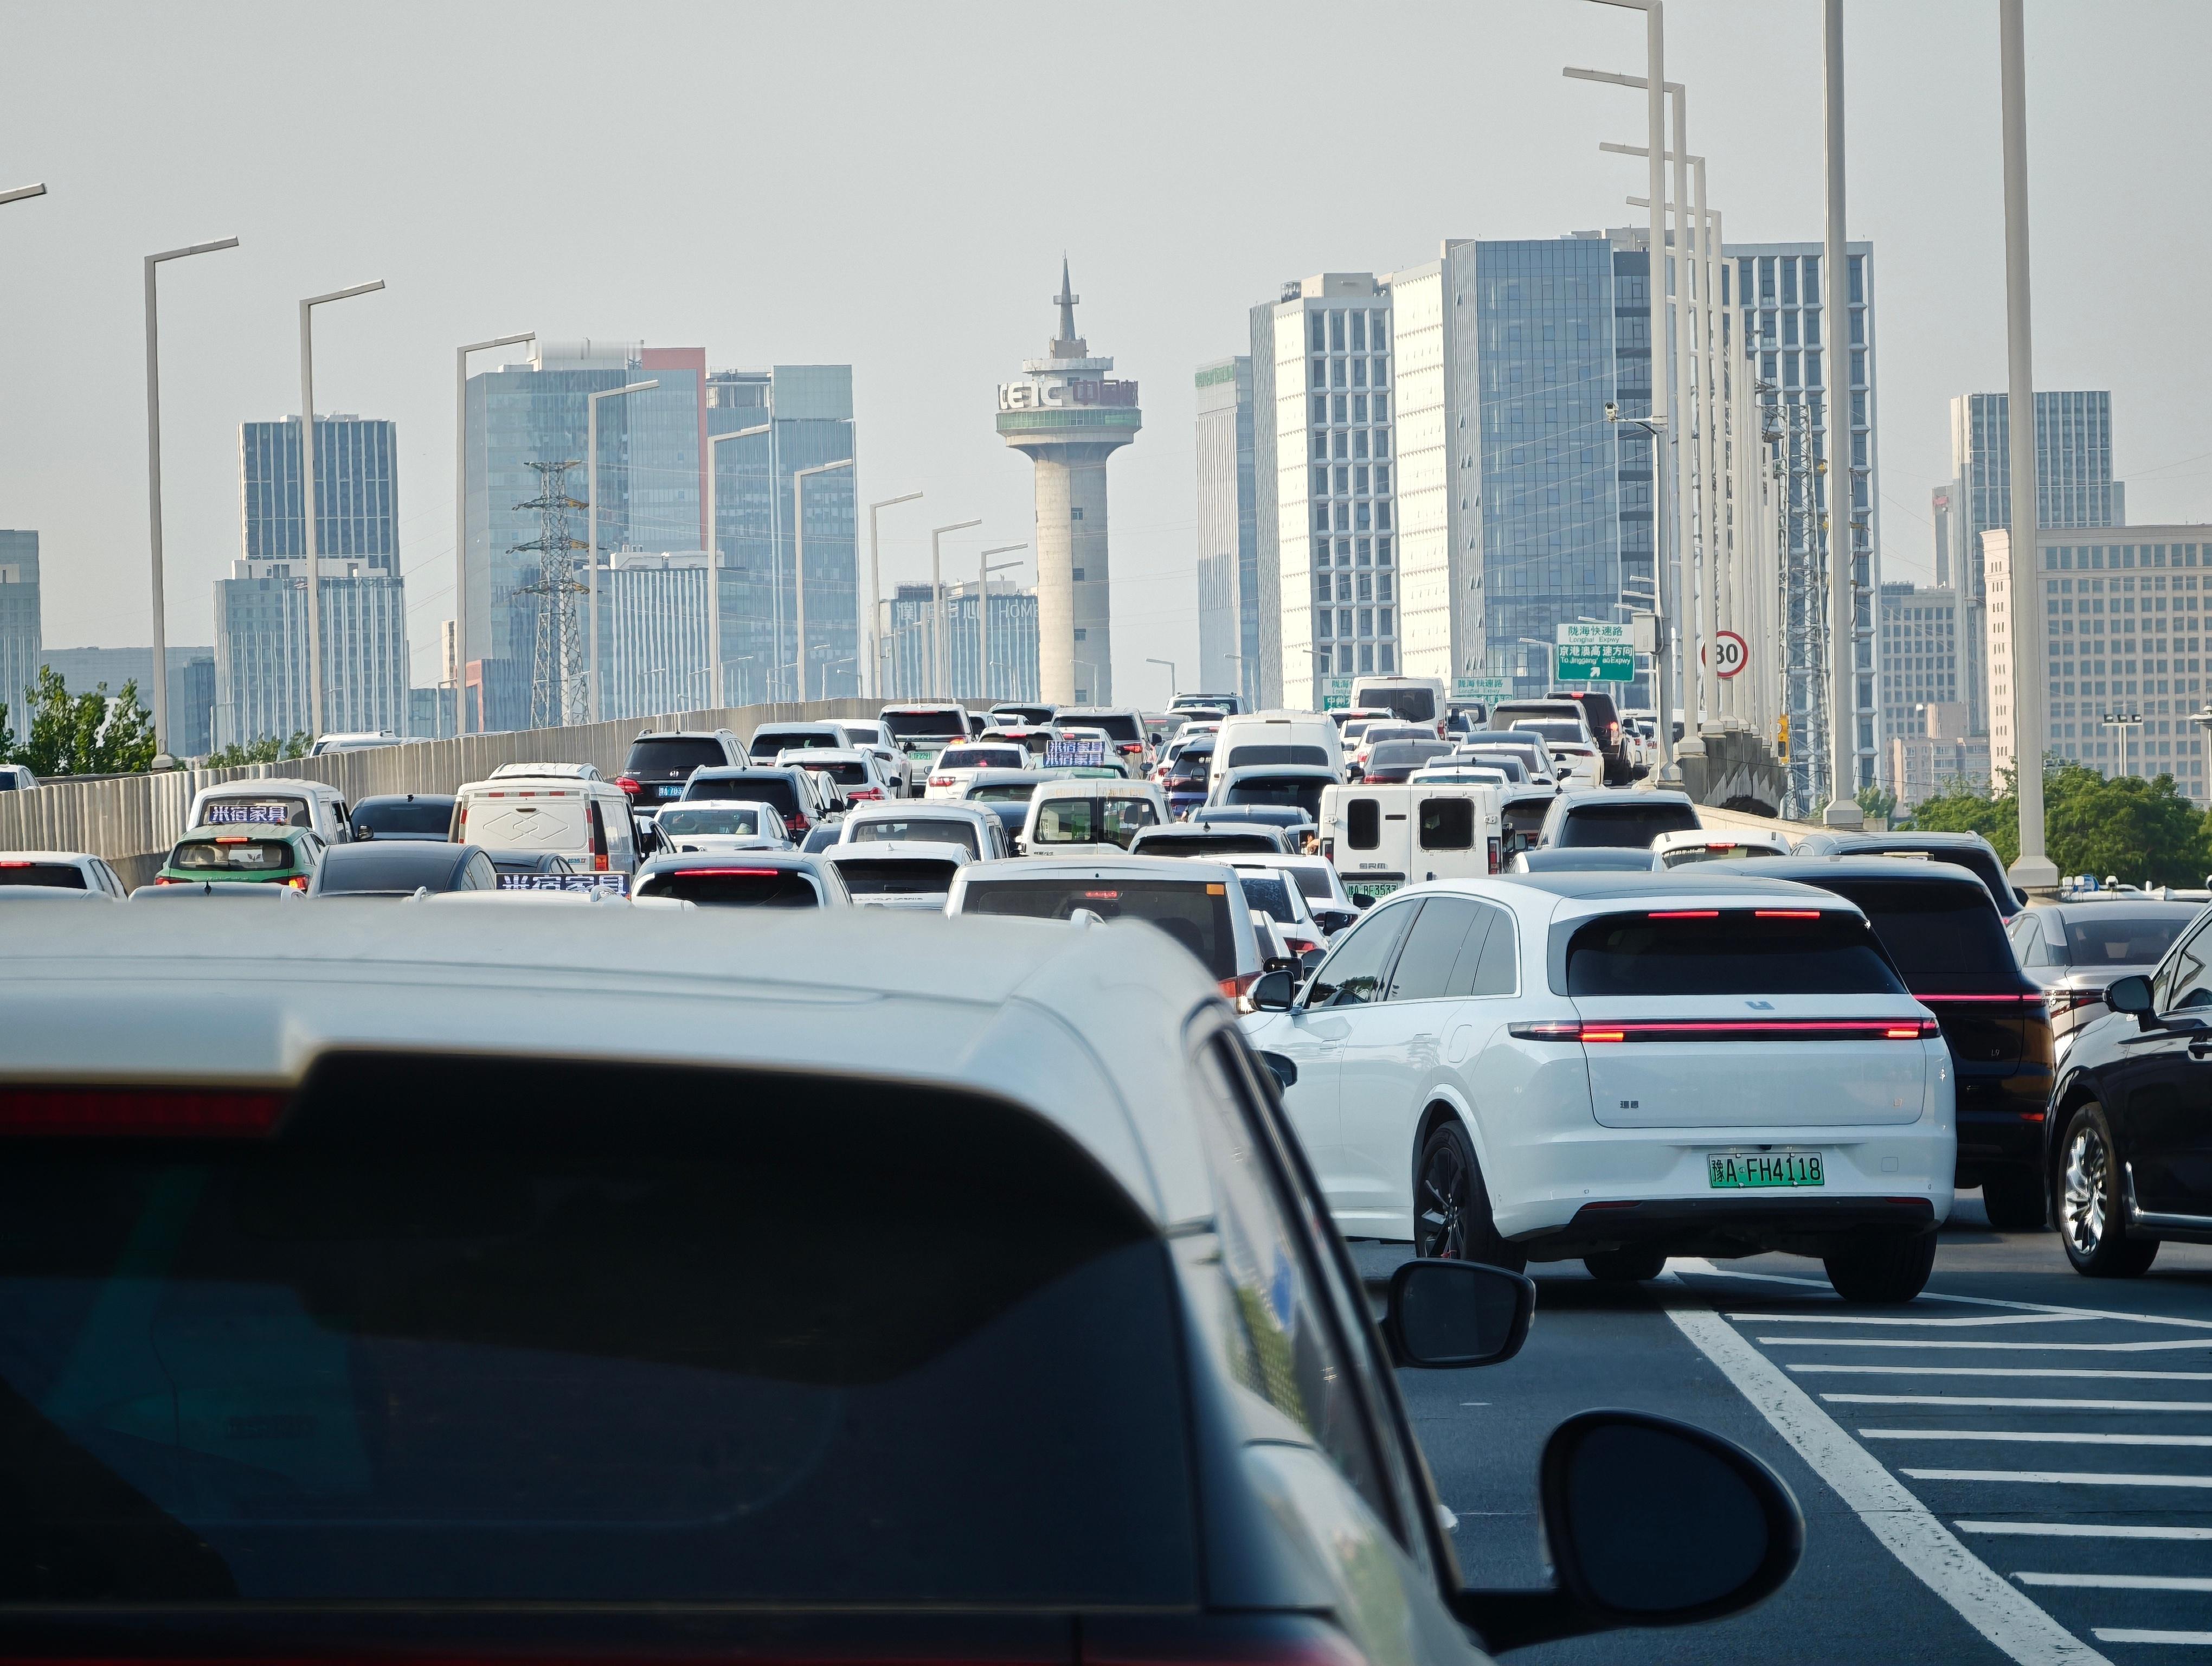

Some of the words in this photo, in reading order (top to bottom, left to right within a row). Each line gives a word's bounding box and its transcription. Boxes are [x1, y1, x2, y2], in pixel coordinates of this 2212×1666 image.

[1568, 626, 1623, 636] 陇海快速路
[1611, 657, 1631, 665] Expwy
[212, 806, 286, 821] 米宿家具
[1746, 1157, 1821, 1181] FH4118
